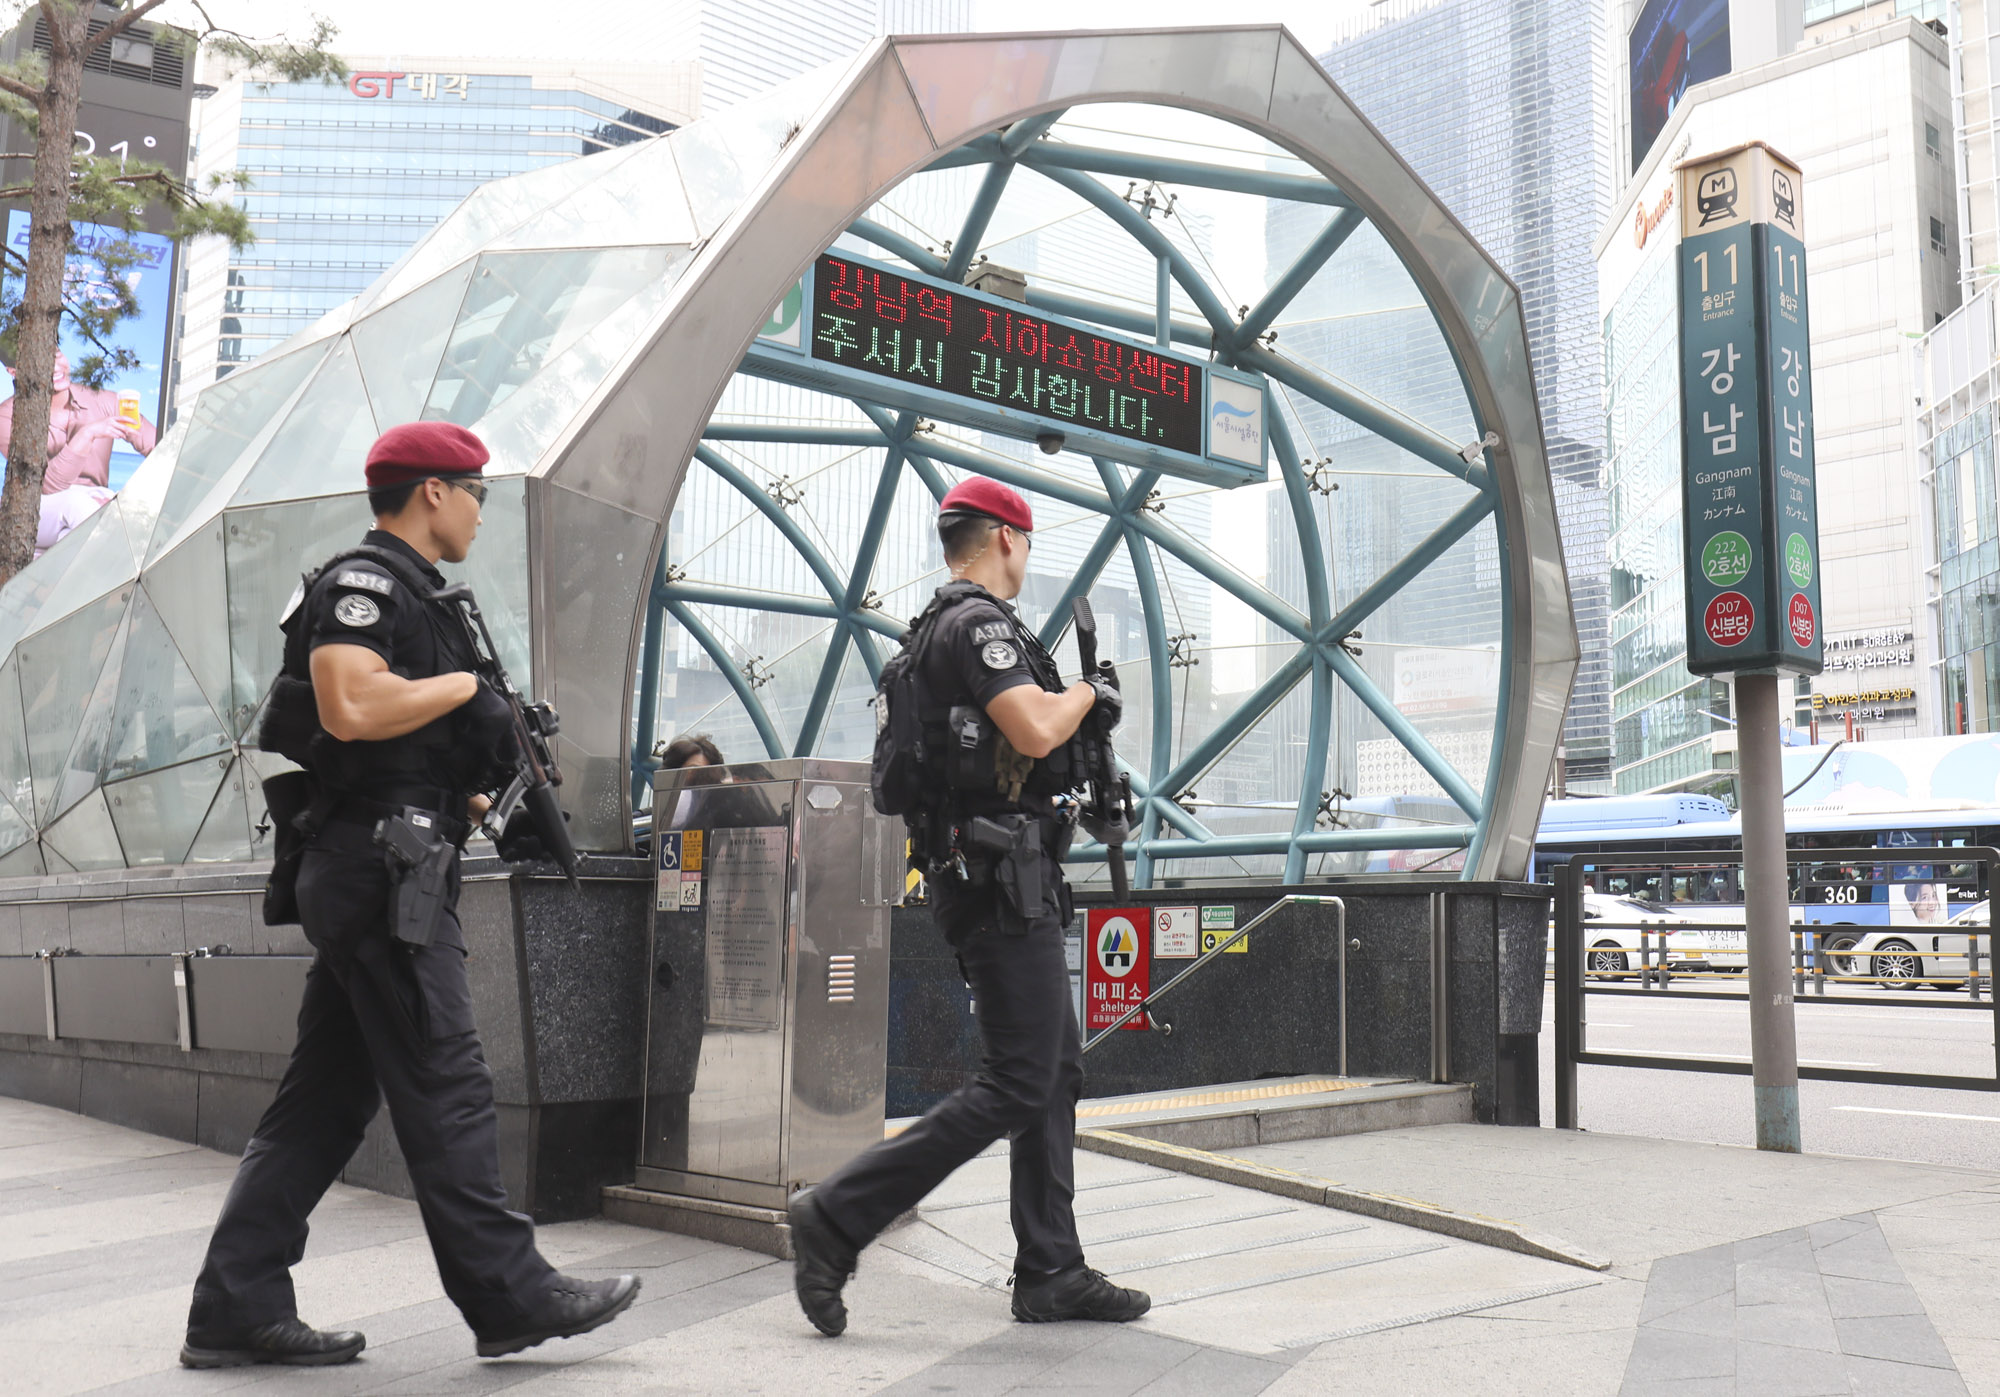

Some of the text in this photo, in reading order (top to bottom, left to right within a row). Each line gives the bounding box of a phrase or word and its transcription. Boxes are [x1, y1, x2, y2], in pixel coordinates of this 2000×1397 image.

[1694, 243, 1738, 292] 11
[1774, 245, 1799, 296] 11
[1701, 290, 1736, 312] 출입구
[1779, 291, 1798, 313] 출입구
[1703, 308, 1735, 321] Entrance
[1780, 308, 1798, 324] Entrance
[828, 260, 1190, 403] 강남역 지하쇼핑센터
[817, 313, 1164, 437] 주셔서 감사합니다.
[1700, 342, 1744, 456] 강남
[1781, 346, 1805, 459] 강남
[1216, 416, 1258, 444] 서울시설공단
[1695, 465, 1752, 485] Gangnam
[1780, 465, 1811, 487] Gangnam
[1712, 485, 1736, 501] 江南
[1789, 487, 1803, 504] 江南
[1703, 503, 1746, 521] カンナム
[1785, 504, 1808, 522] カンナム
[1715, 541, 1737, 554] 222
[1793, 542, 1805, 556] 222
[1708, 553, 1747, 578] 2호선
[1789, 558, 1810, 581] 2호선
[1716, 600, 1741, 615] D07
[1794, 601, 1808, 616] D07
[975, 623, 1011, 642] A311
[1710, 614, 1749, 639] 신분당
[1792, 619, 1812, 640] 신분당
[1863, 633, 1906, 648] SURGERY
[1825, 886, 1857, 904] 360
